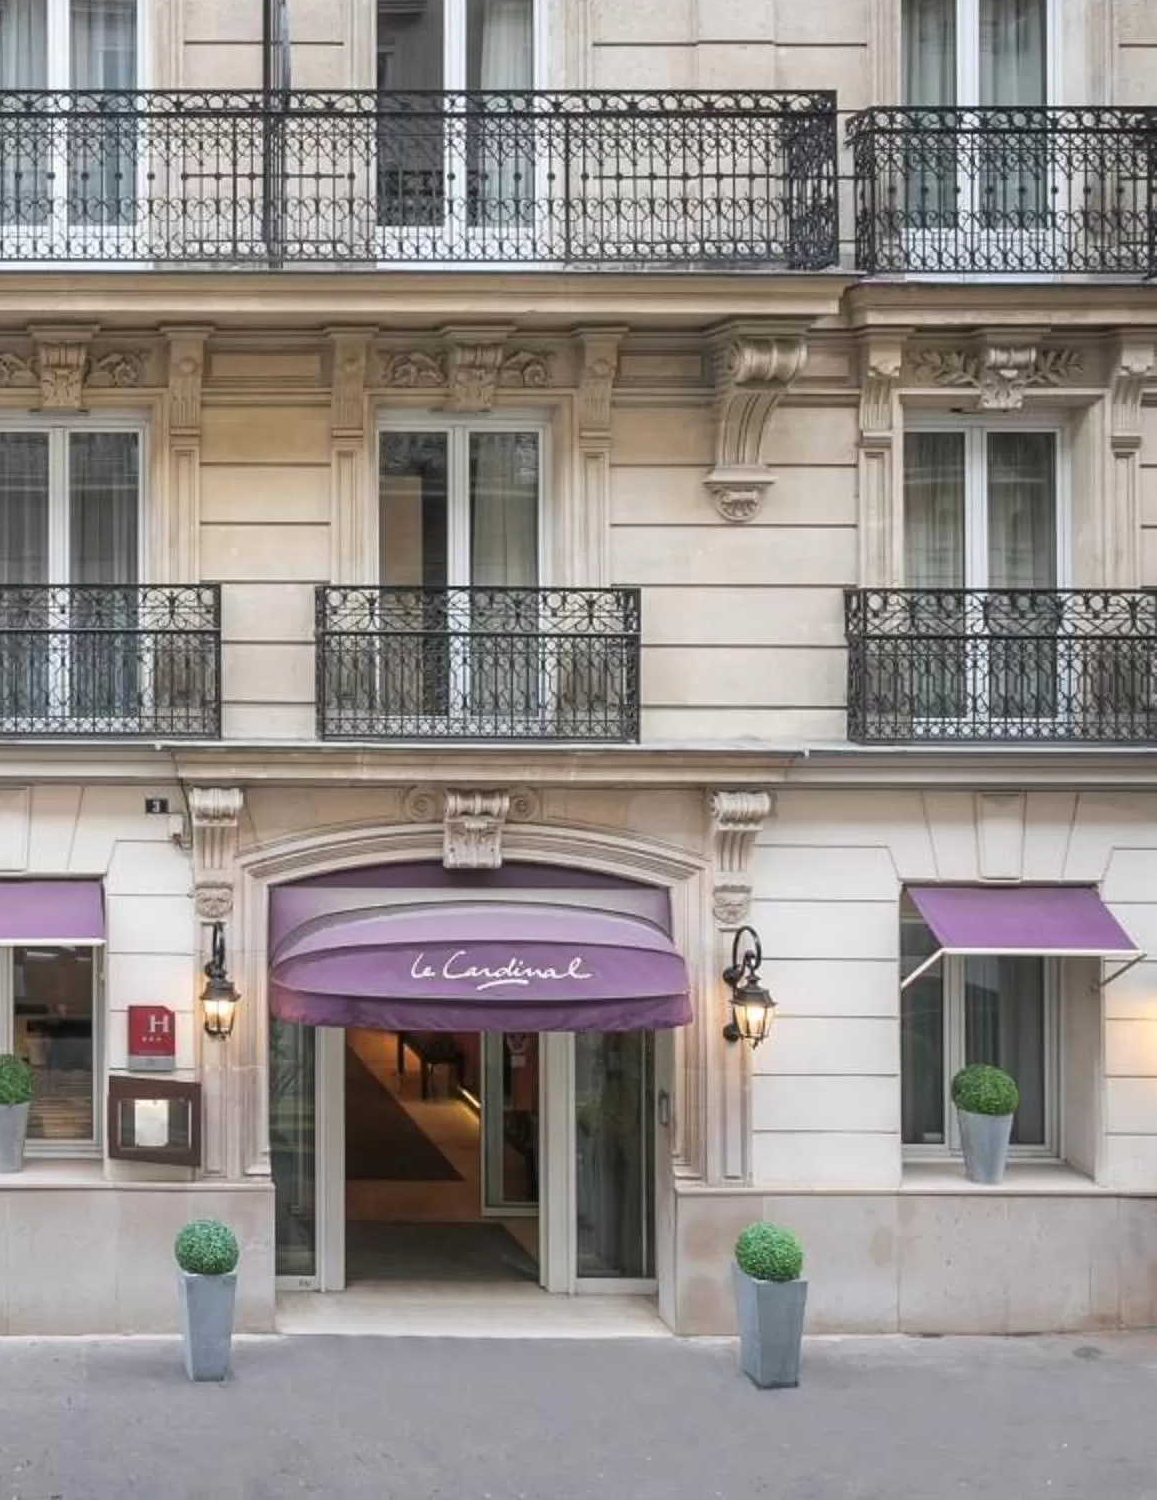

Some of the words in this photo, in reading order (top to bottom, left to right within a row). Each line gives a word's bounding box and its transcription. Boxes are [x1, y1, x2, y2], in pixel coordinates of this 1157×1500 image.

[151, 800, 160, 812] 3
[410, 952, 435, 979] Le
[443, 949, 592, 979] Cardinal
[149, 1014, 170, 1033] H
